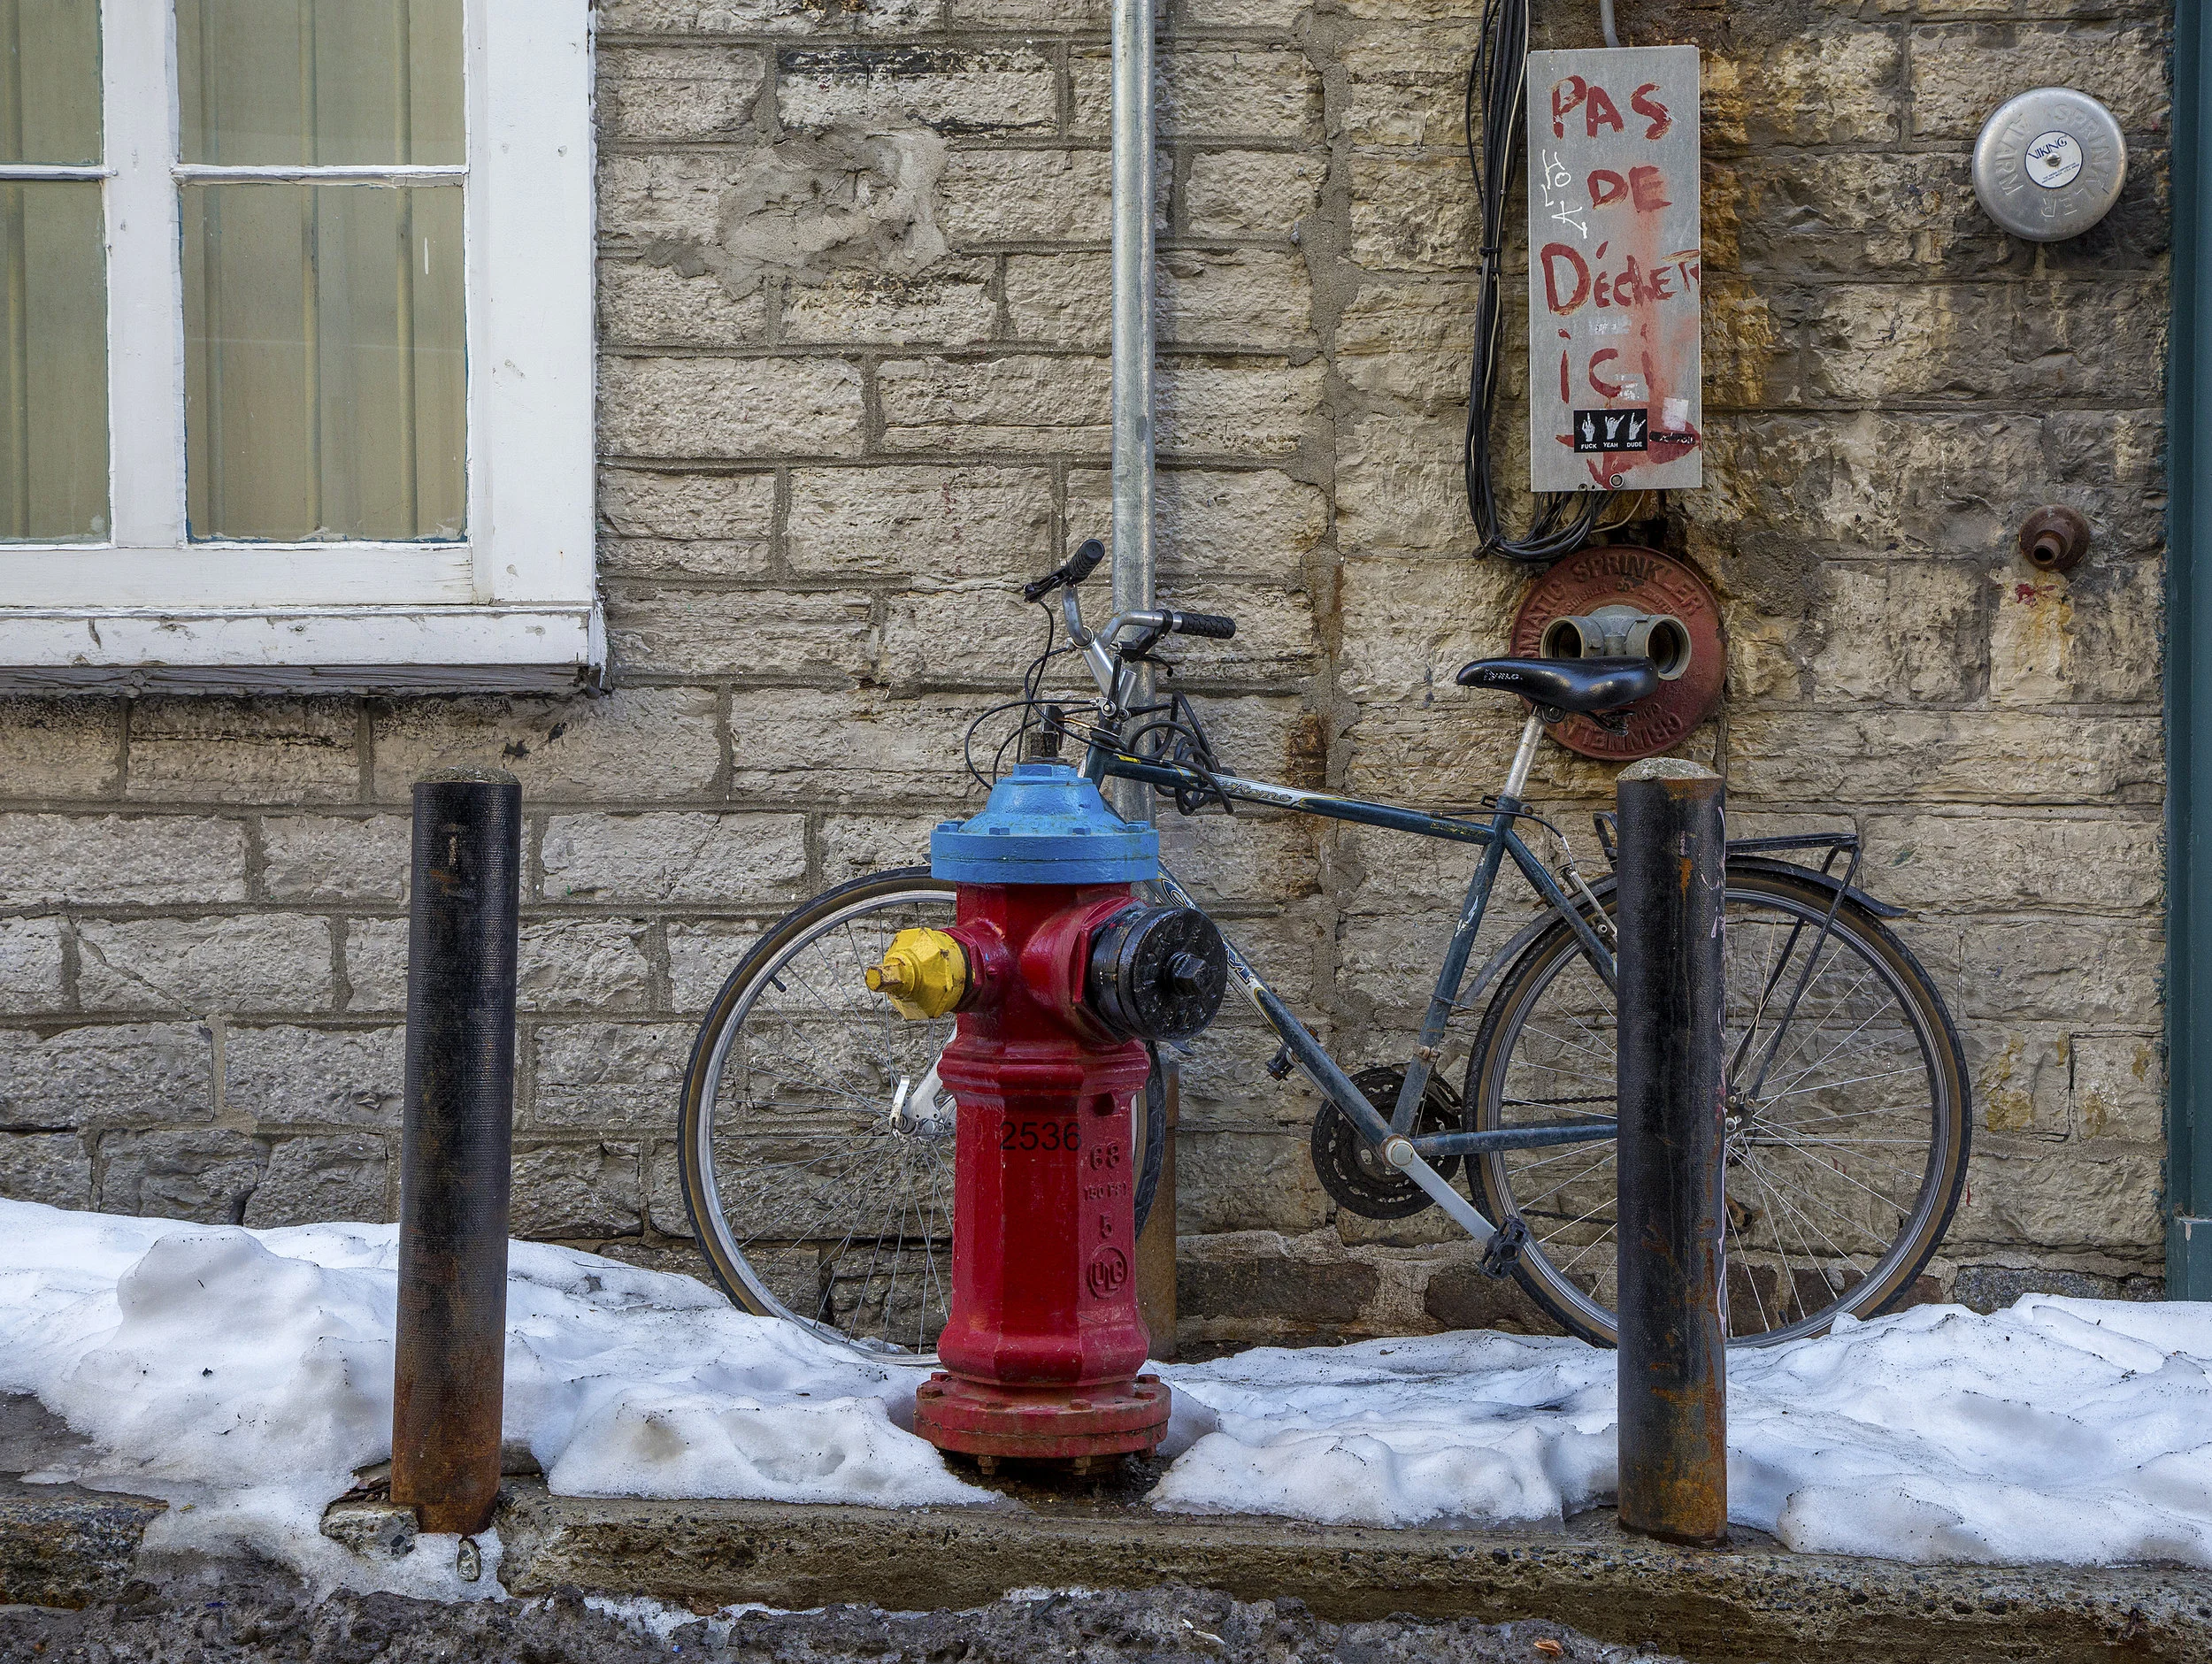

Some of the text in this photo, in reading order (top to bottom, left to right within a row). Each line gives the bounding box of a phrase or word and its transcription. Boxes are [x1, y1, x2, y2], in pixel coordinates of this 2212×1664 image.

[1551, 74, 1672, 142] PAS
[2027, 136, 2068, 160] VIKING
[1586, 165, 1672, 211] DE
[1573, 553, 1706, 617] SPRINKLER
[999, 1121, 1082, 1151] 2536
